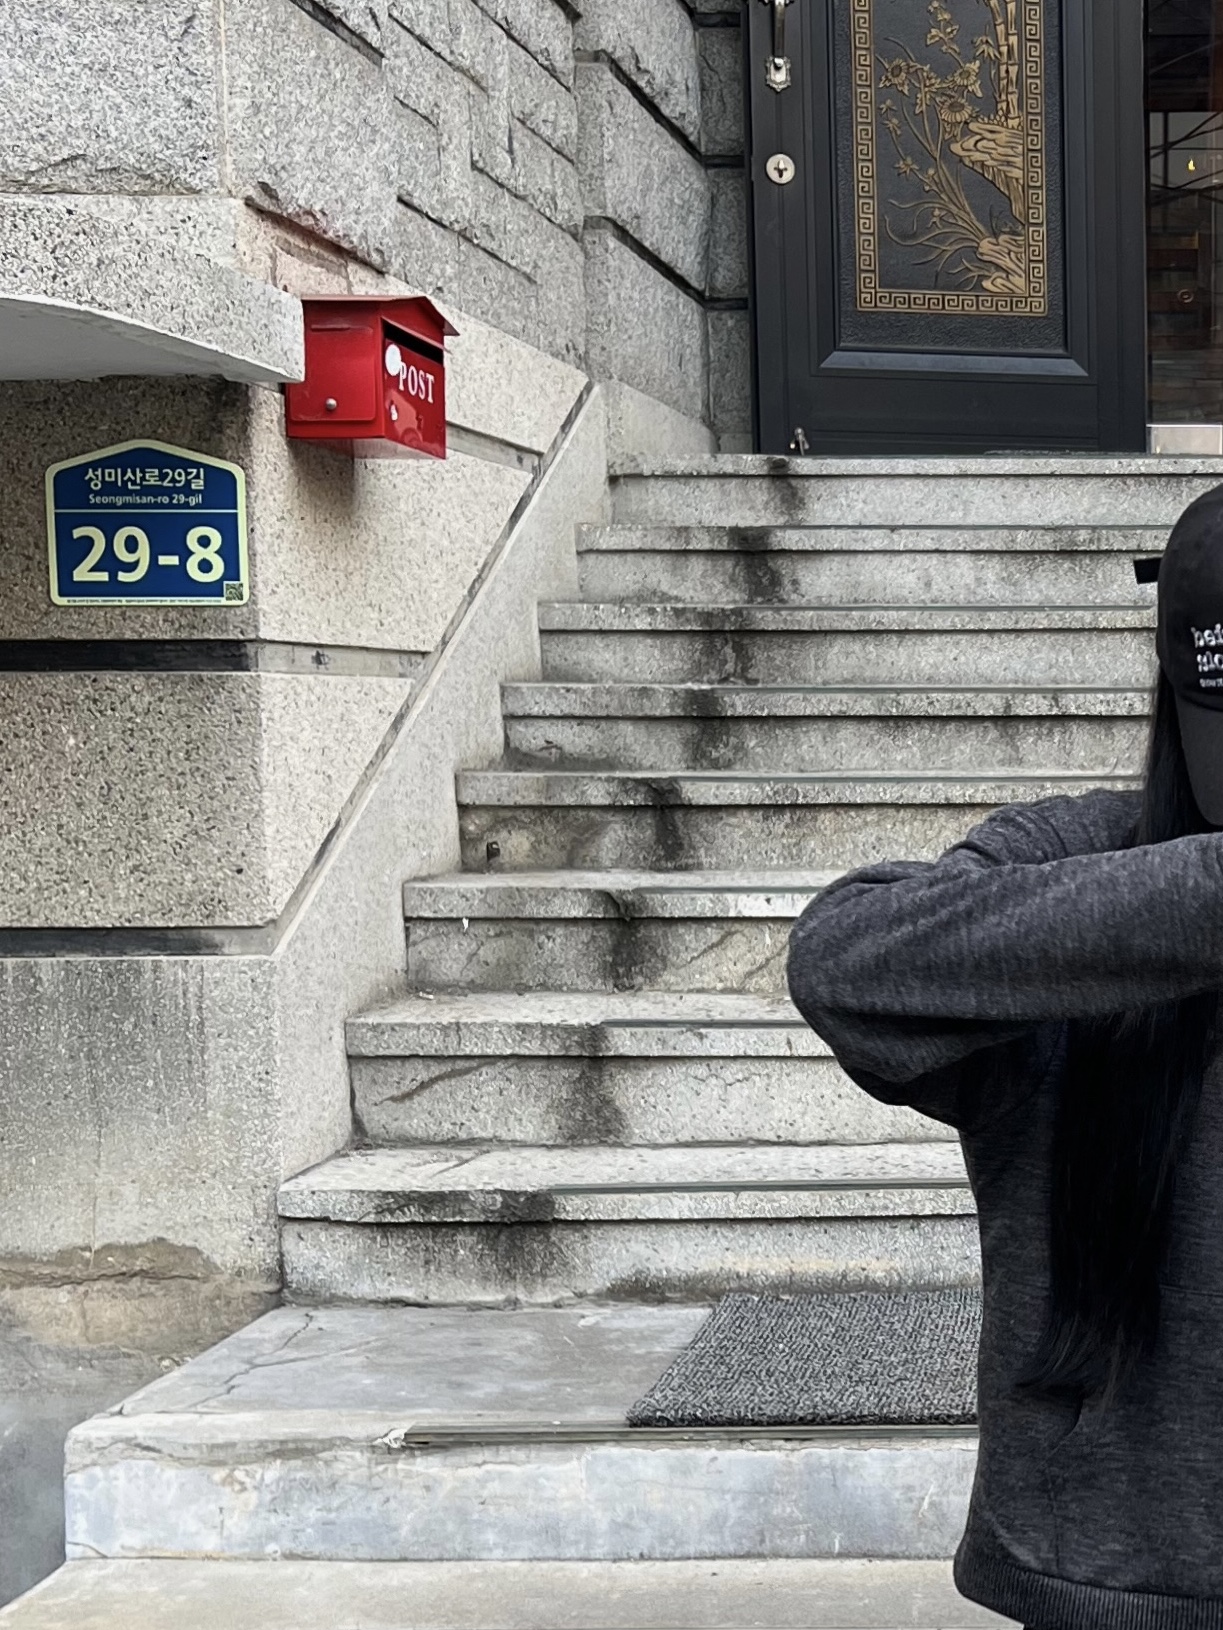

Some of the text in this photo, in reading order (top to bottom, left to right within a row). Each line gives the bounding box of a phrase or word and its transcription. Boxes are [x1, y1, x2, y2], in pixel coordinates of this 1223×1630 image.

[398, 361, 435, 404] POST
[84, 467, 206, 490] 성미산로29길
[89, 493, 203, 506] Seongmisan-ro 29-gil
[71, 525, 226, 583] 29-8
